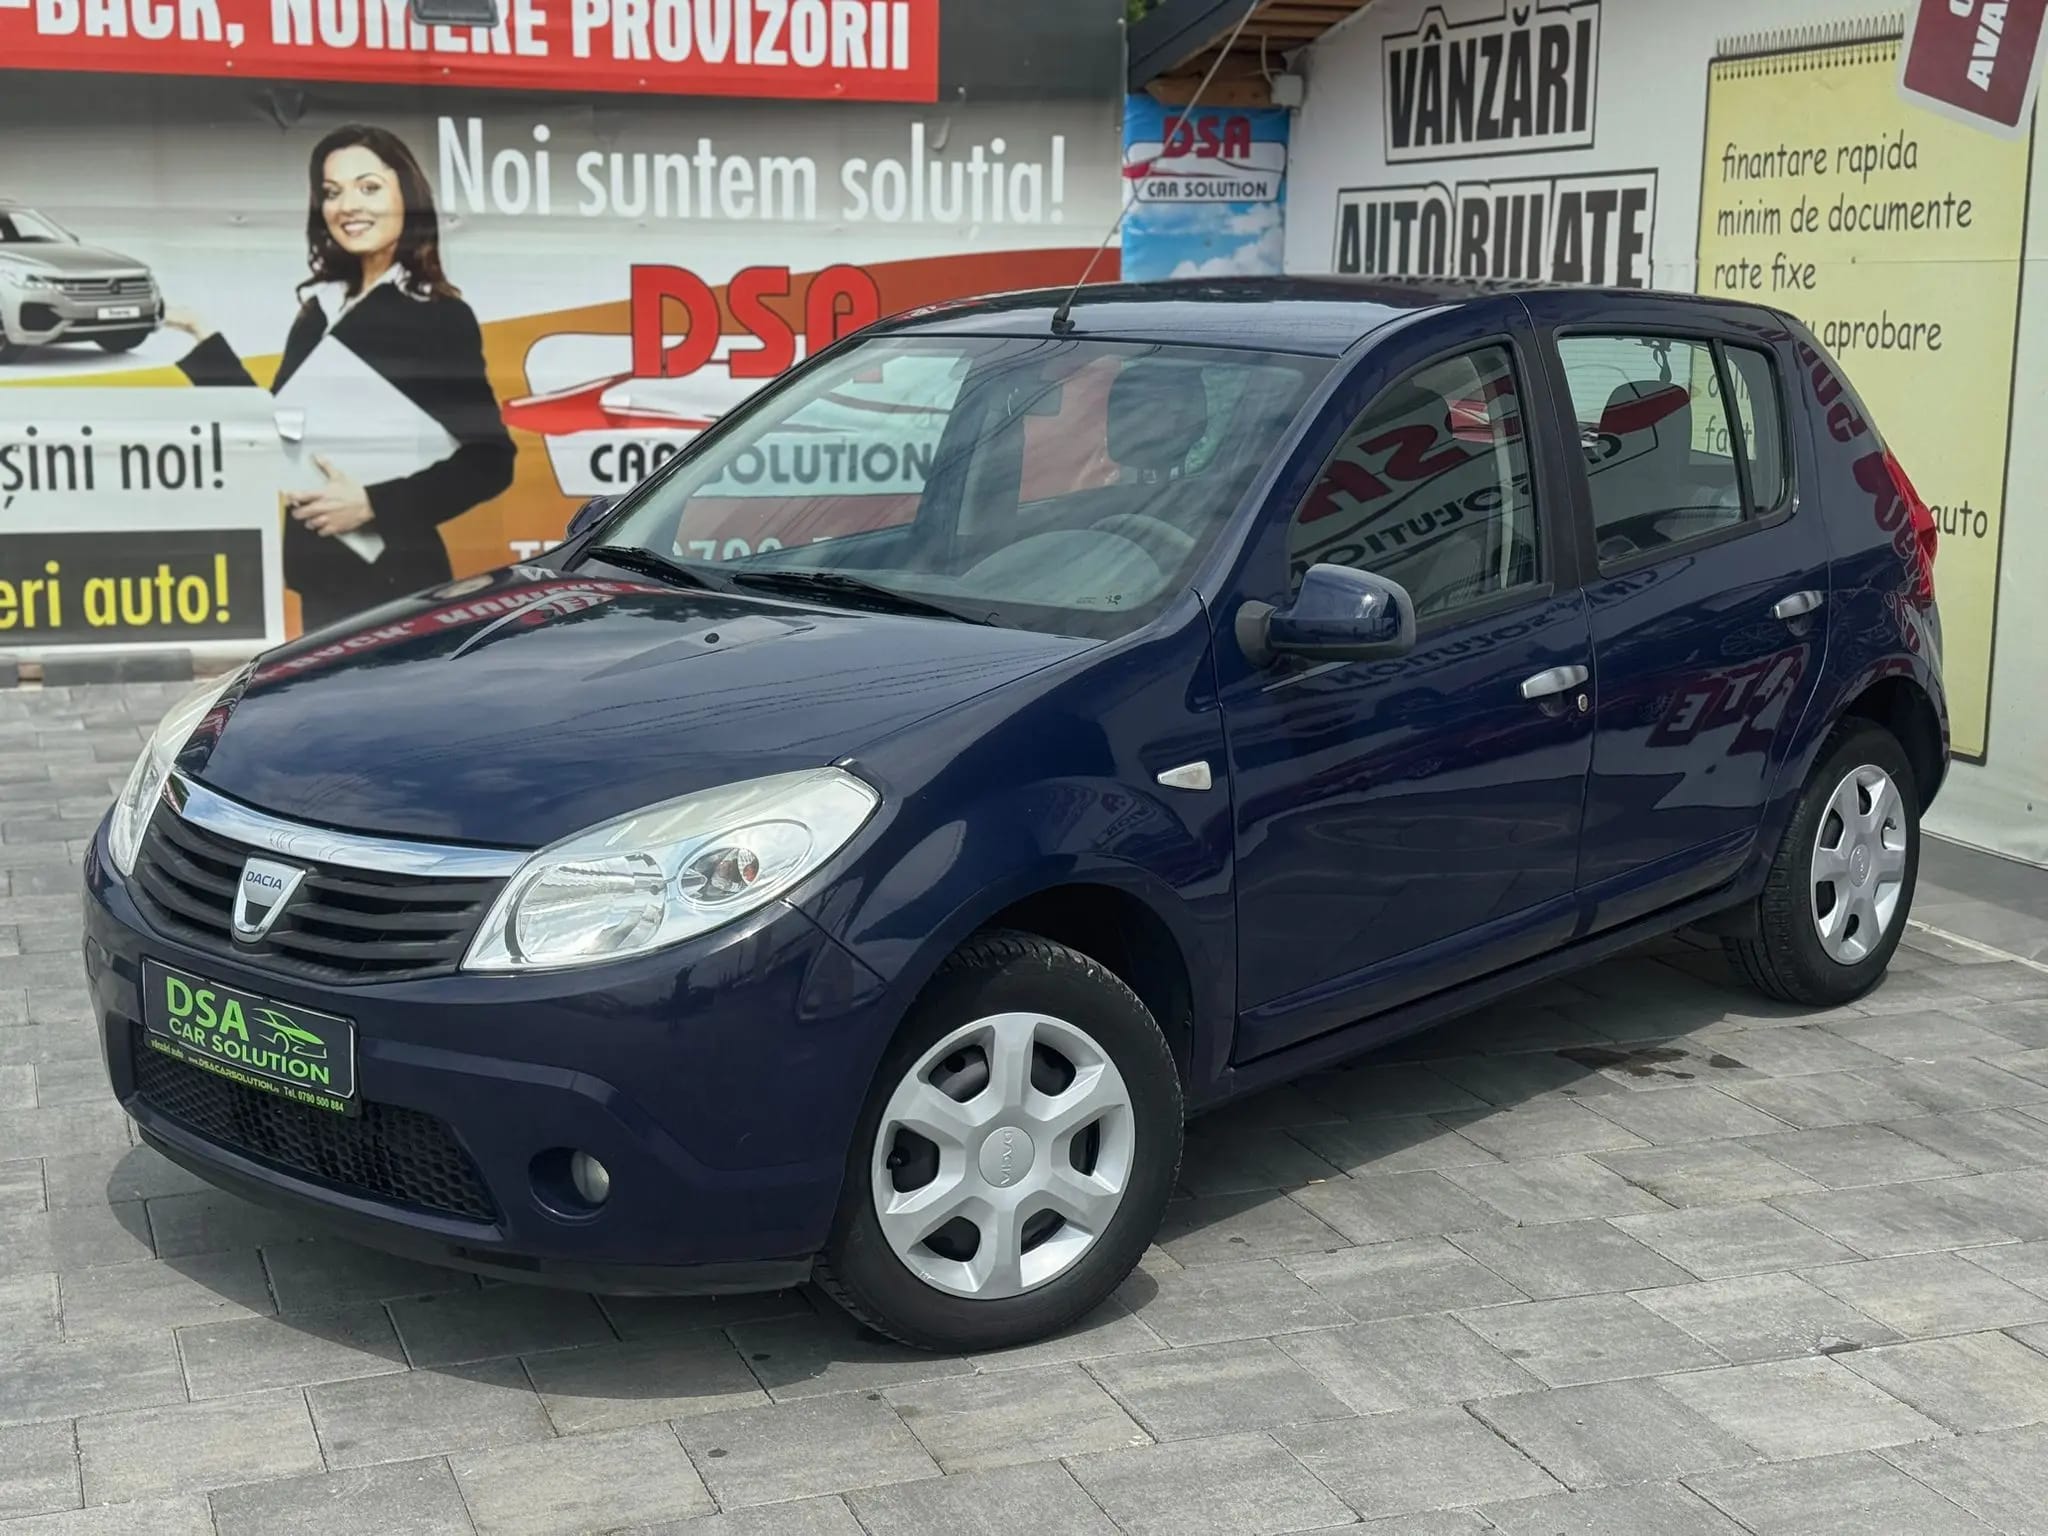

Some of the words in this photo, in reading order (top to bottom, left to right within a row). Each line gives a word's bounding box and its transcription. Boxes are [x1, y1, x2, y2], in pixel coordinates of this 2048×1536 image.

[570, 0, 910, 71] PROVIZORII
[1965, 0, 2011, 93] AVA
[1389, 4, 1592, 149] VÂNZĂRI
[1161, 115, 1251, 159] DSA
[1722, 142, 1827, 183] finantare
[1836, 128, 1918, 185] rapida
[438, 116, 550, 216] Noi
[577, 138, 817, 222] suntem
[841, 122, 1065, 240] soluția!
[1147, 181, 1179, 198] CAR
[1184, 181, 1268, 198] SOLUTION
[1717, 198, 1781, 237] minim
[1790, 194, 1819, 233] de
[1828, 192, 1972, 232] documente
[1714, 257, 1762, 290] rate
[1771, 252, 1816, 292] fixe
[630, 263, 882, 383] DSA
[1823, 309, 1943, 360] aprobare
[120, 421, 224, 490] noi!
[1929, 499, 1988, 539] auto
[0, 559, 62, 629] eri
[83, 553, 231, 628] auto!
[245, 870, 283, 891] DACIA
[166, 976, 249, 1042] DSA
[168, 1017, 207, 1047] CAR
[212, 1035, 330, 1085] SOLUTION
